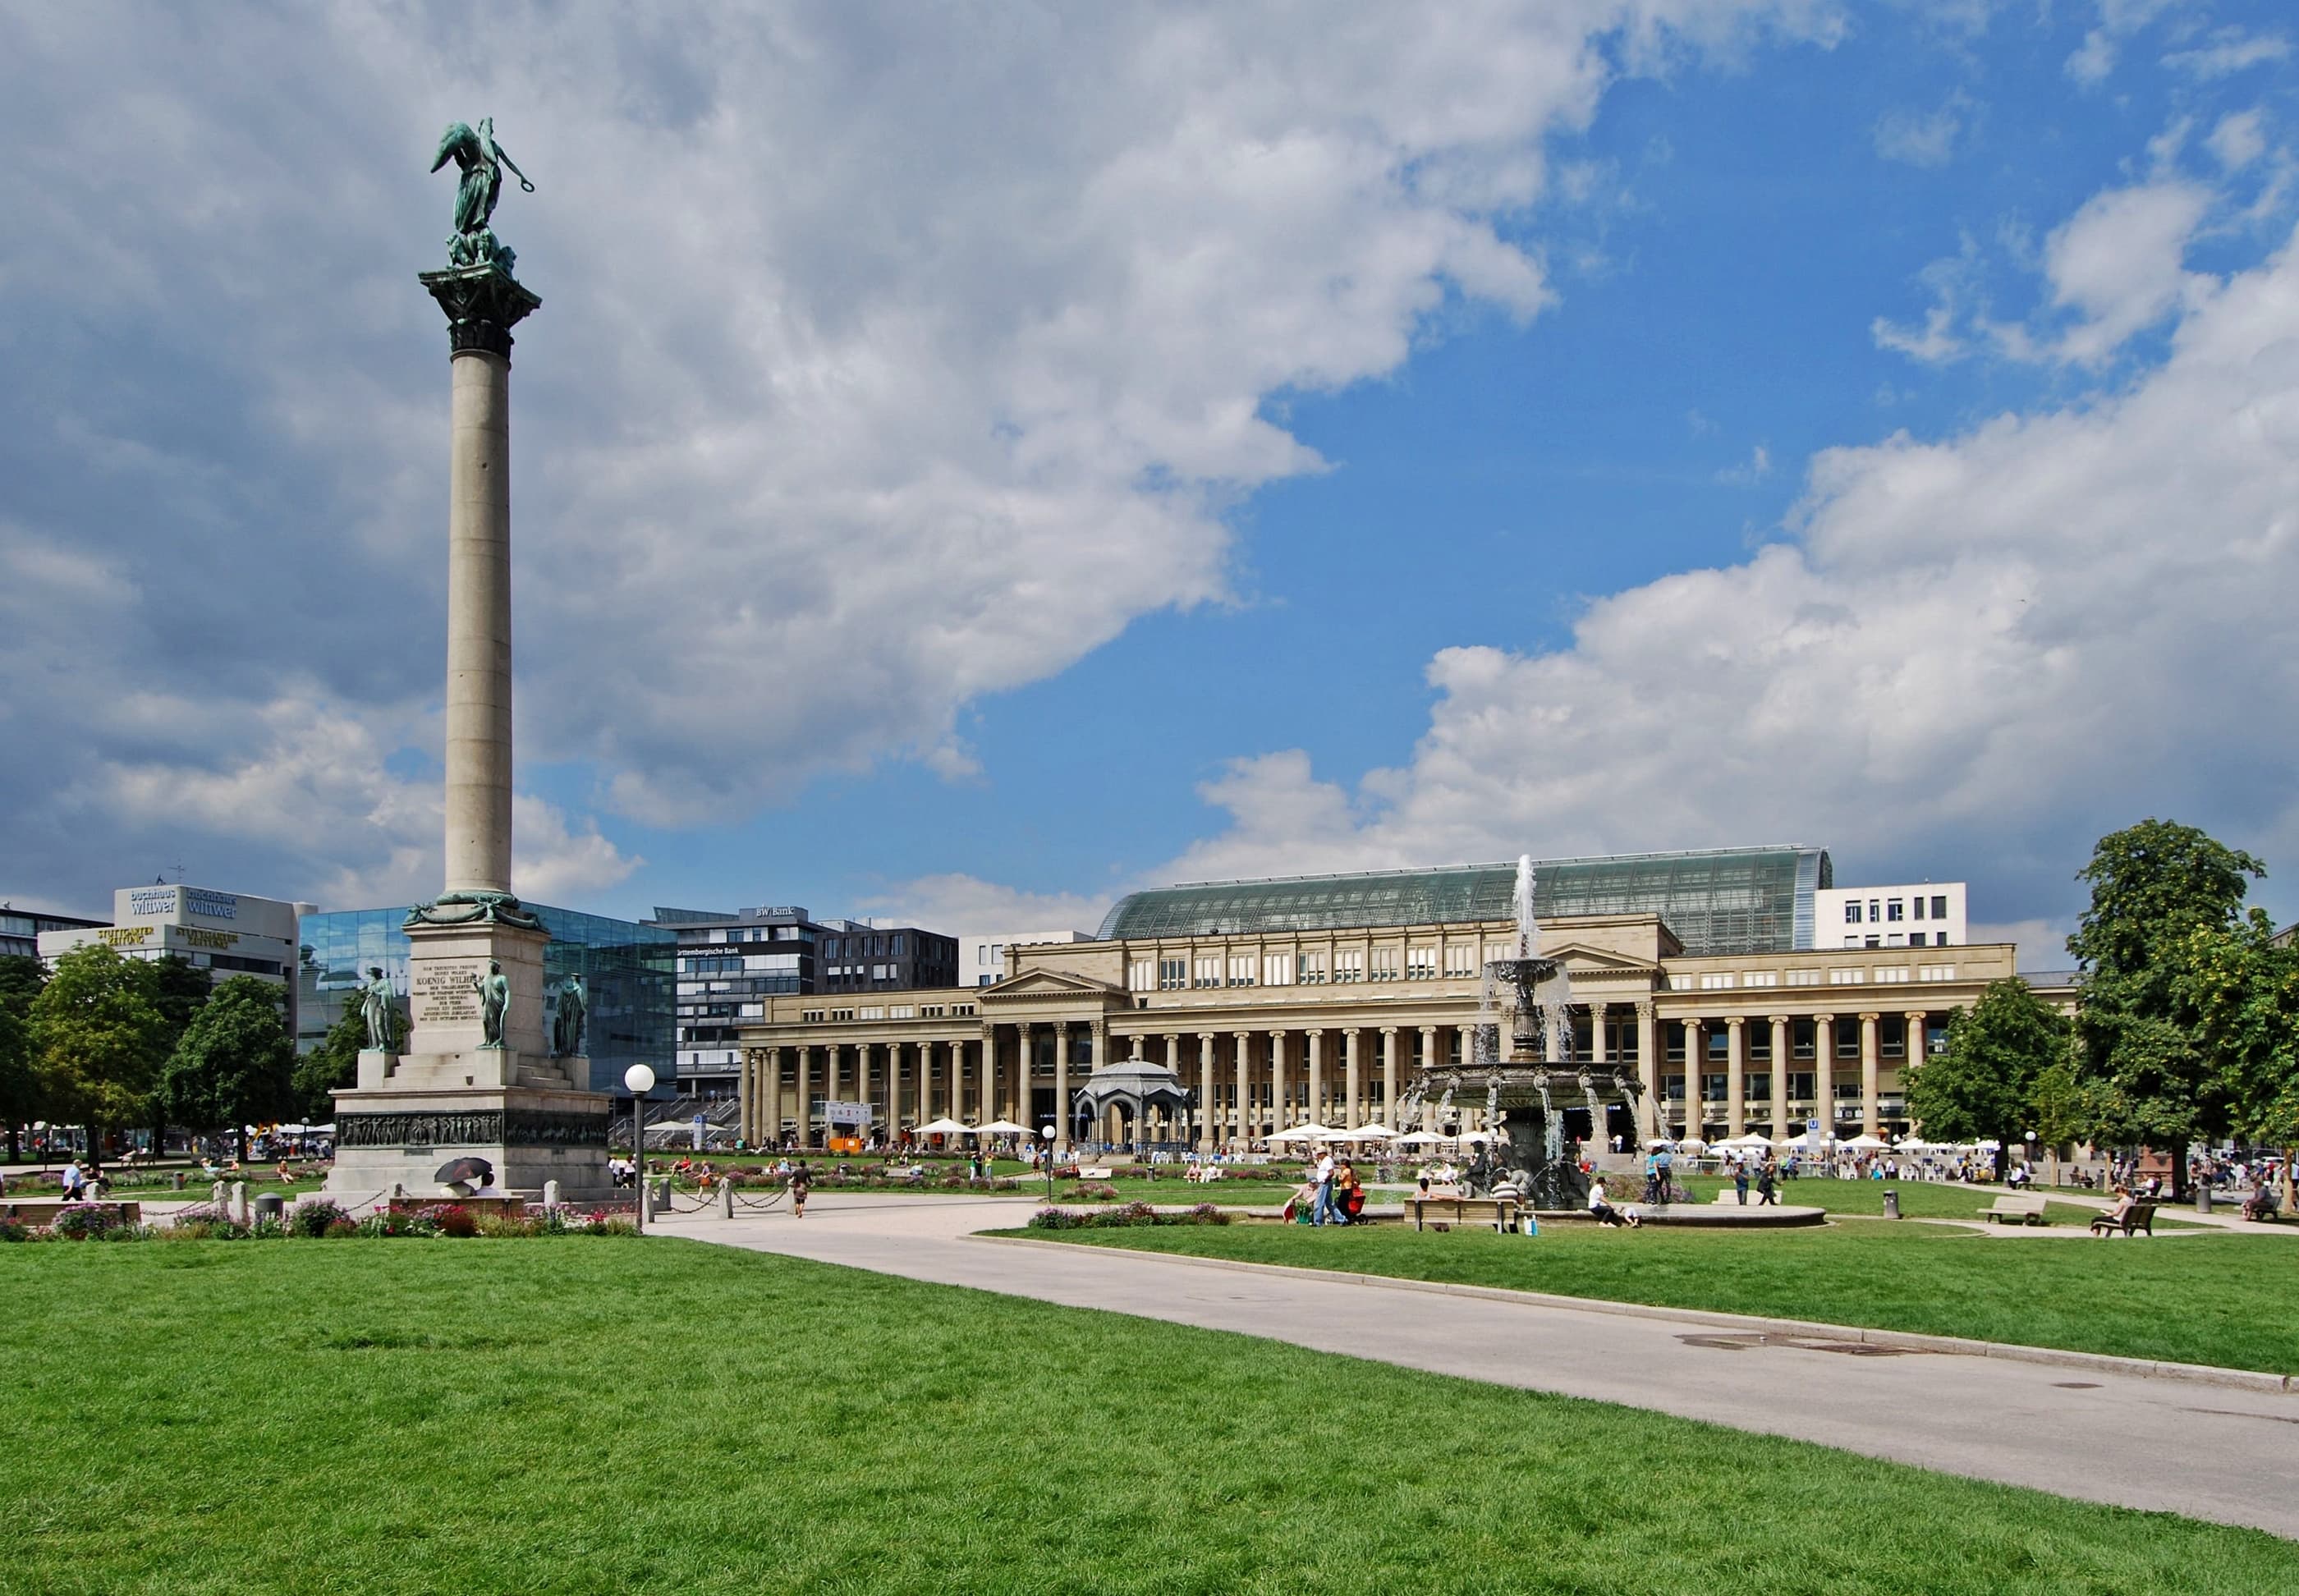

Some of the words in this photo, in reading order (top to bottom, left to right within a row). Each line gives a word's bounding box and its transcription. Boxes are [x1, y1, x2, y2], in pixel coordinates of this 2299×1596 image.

[131, 888, 176, 901] buchhaus
[187, 889, 236, 906] buchhaus
[132, 901, 175, 915] wittwer
[187, 900, 236, 920] wittwer
[756, 907, 769, 916] BW
[773, 906, 794, 915] Bank
[98, 927, 154, 939] STUTTGARTER
[176, 927, 238, 943] STUTTGARTER
[108, 935, 145, 947] ZEITUNG
[416, 977, 446, 985] KOENIG
